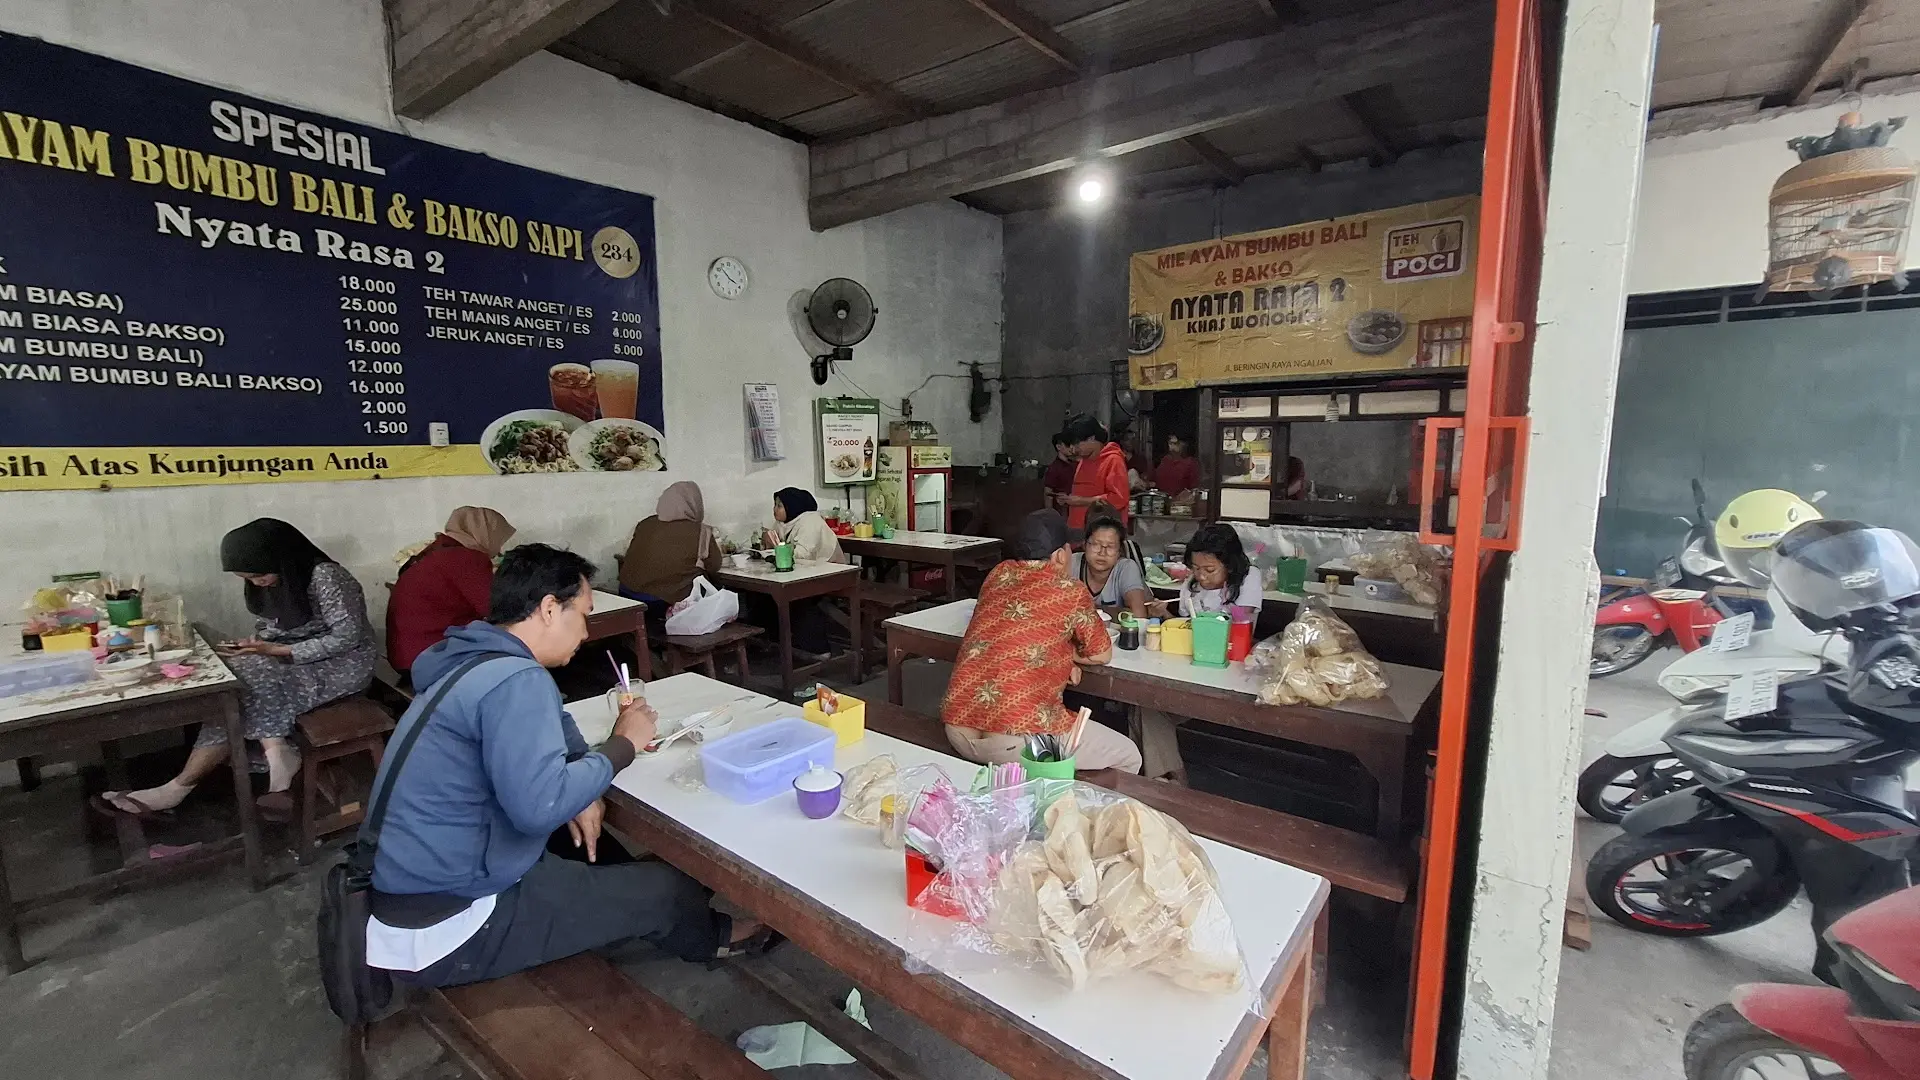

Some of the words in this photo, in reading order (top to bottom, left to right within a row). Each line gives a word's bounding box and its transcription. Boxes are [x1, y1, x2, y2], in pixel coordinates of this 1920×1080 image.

[210, 100, 386, 176] SPESIAL
[125, 136, 278, 207] BUMBU
[290, 171, 377, 225] BALI
[387, 193, 416, 230] &
[423, 199, 518, 249] BAKSO
[526, 220, 584, 261] SAPI
[155, 201, 303, 254] Nyata
[315, 229, 415, 269] Rasa
[425, 250, 445, 275] 2
[1157, 252, 1186, 270] MIE
[1189, 243, 1240, 265] AYAM
[1245, 229, 1315, 257] BUMBU
[1320, 220, 1368, 244] BALI
[1393, 232, 1420, 247] TEH
[601, 242, 633, 262] 234
[1393, 252, 1455, 276] POCI
[338, 275, 396, 295] 18.000
[1214, 270, 1227, 287] &
[1232, 260, 1293, 284] BAKSO
[26, 286, 124, 315] BIASA)
[340, 296, 398, 315] 25.000
[422, 285, 456, 302] TEH
[460, 291, 515, 310] TAWAR
[517, 298, 565, 315] ANGET
[569, 305, 573, 316] /
[576, 305, 593, 319] ES
[1170, 290, 1244, 320] NYATA
[1330, 277, 1346, 302] 2
[31, 313, 121, 335] BIASA
[126, 321, 225, 346] BAKSO)
[342, 317, 400, 335] 11.000
[424, 305, 457, 321] TEH
[462, 309, 510, 327] MANIS
[514, 316, 562, 332] ANGET
[565, 322, 570, 333] /
[573, 322, 590, 335] ES
[611, 310, 642, 325] 2.000
[1187, 317, 1225, 334] KHAS
[344, 338, 401, 355] 15.000
[426, 325, 481, 342] JERUK
[484, 331, 535, 347] ANGET
[539, 336, 543, 348] /
[546, 337, 564, 350] ES
[25, 338, 129, 361] BUMBU
[137, 345, 203, 367] BALI)
[613, 343, 644, 357] 5.000
[348, 359, 403, 375] 12.000
[1233, 362, 1269, 372] BERINGIN
[1272, 360, 1291, 369] RAYA
[0, 363, 61, 381] YAM
[69, 366, 168, 387] BUMBU
[176, 371, 232, 389] BALI
[238, 374, 323, 395] BAKSO)
[349, 379, 405, 395] 16.000
[361, 400, 407, 415] 2.000
[363, 420, 408, 435] 1.500
[61, 454, 139, 476] Atas
[148, 452, 314, 478] Kunjungan
[324, 452, 389, 470] Anda
